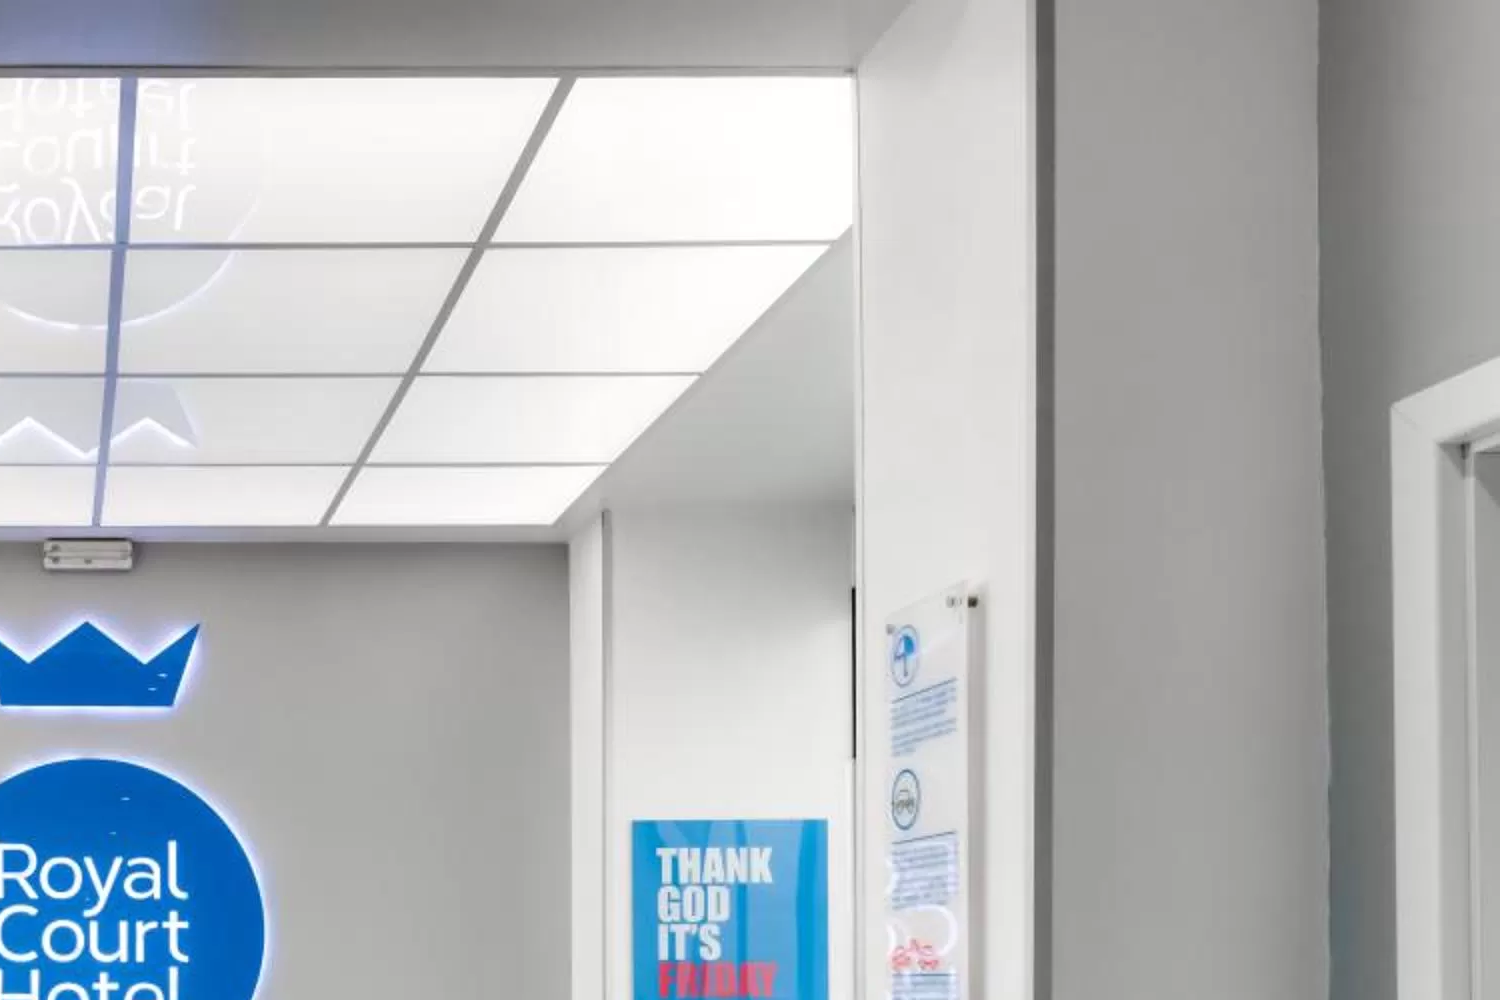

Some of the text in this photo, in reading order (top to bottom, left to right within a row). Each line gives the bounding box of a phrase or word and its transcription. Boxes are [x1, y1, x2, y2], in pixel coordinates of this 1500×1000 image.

[655, 847, 774, 884] THANK
[657, 885, 731, 922] GOD
[658, 923, 722, 961] IT'S
[658, 961, 778, 999] FRIDAY
